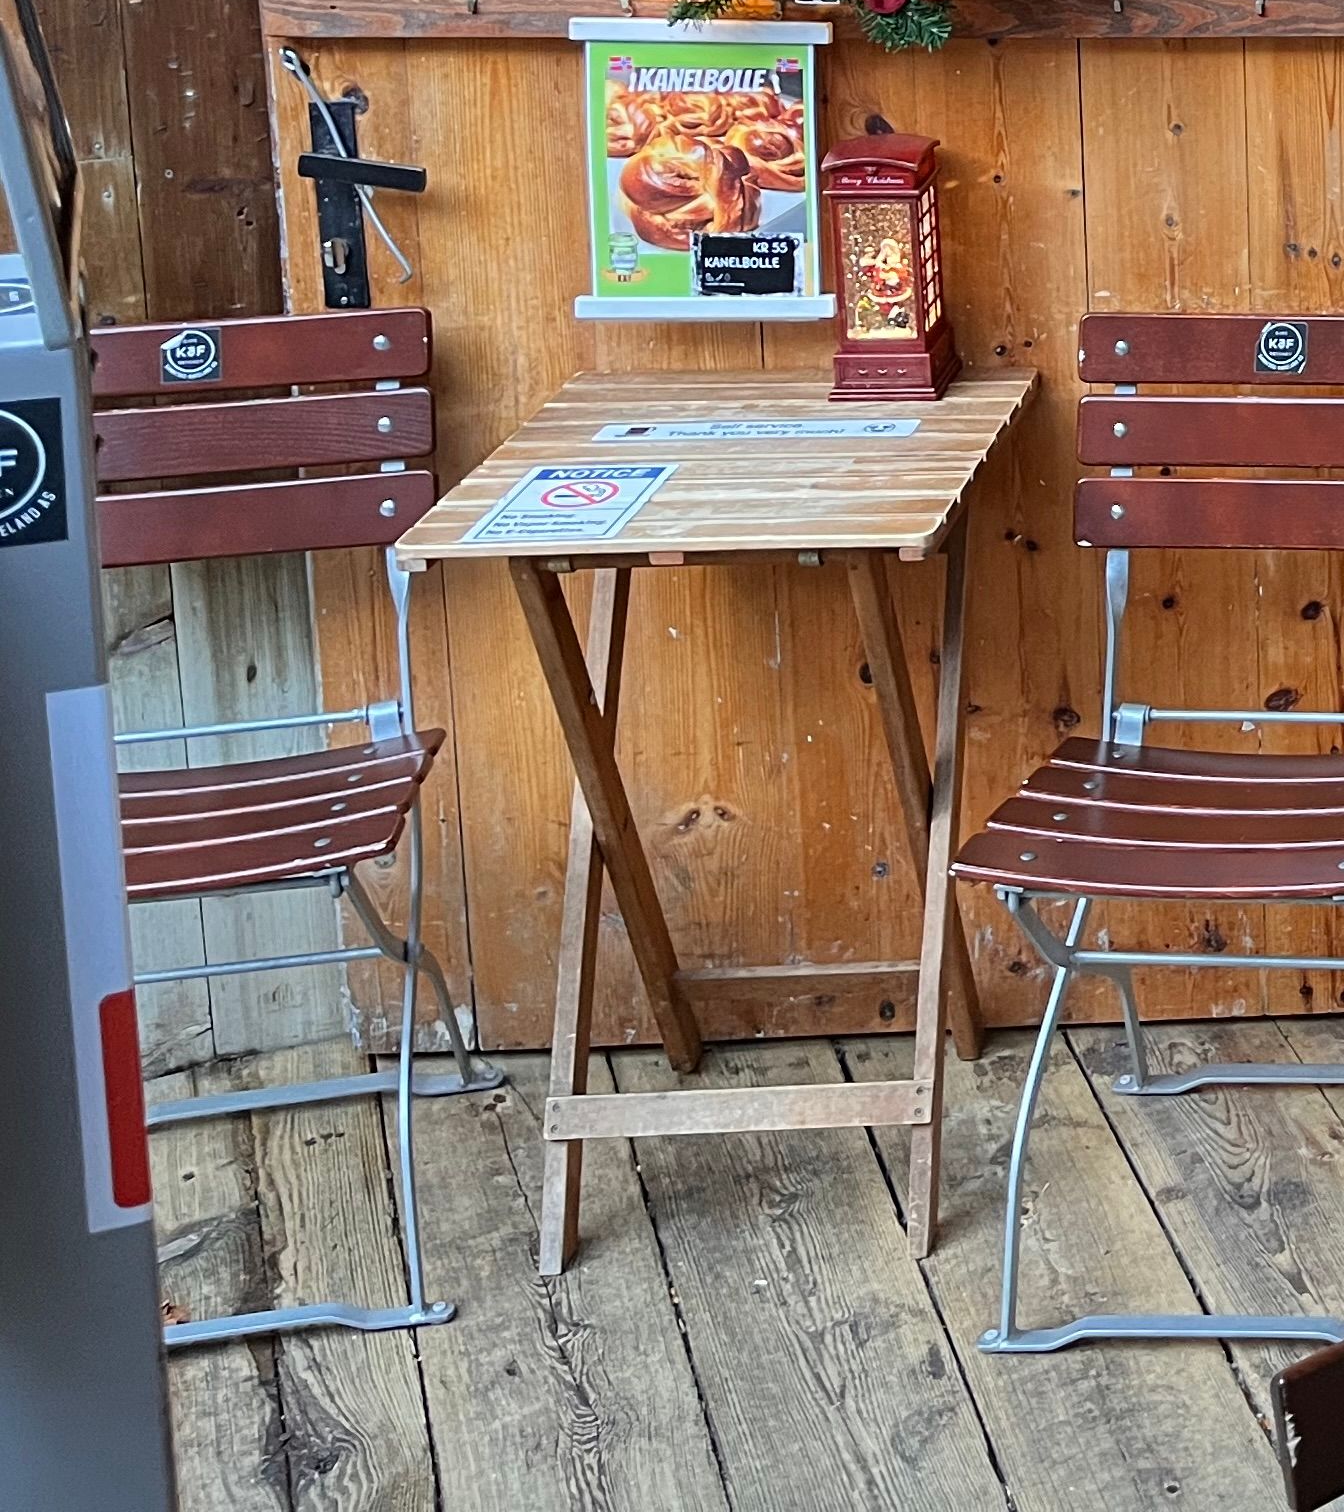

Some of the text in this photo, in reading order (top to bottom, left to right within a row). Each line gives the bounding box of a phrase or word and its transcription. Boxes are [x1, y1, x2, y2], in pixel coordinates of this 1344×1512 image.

[752, 241, 789, 254] KR 55
[704, 256, 780, 269] KANELBOLLE
[548, 468, 652, 479] NOTICE
[0, 491, 57, 537] ELAND AS
